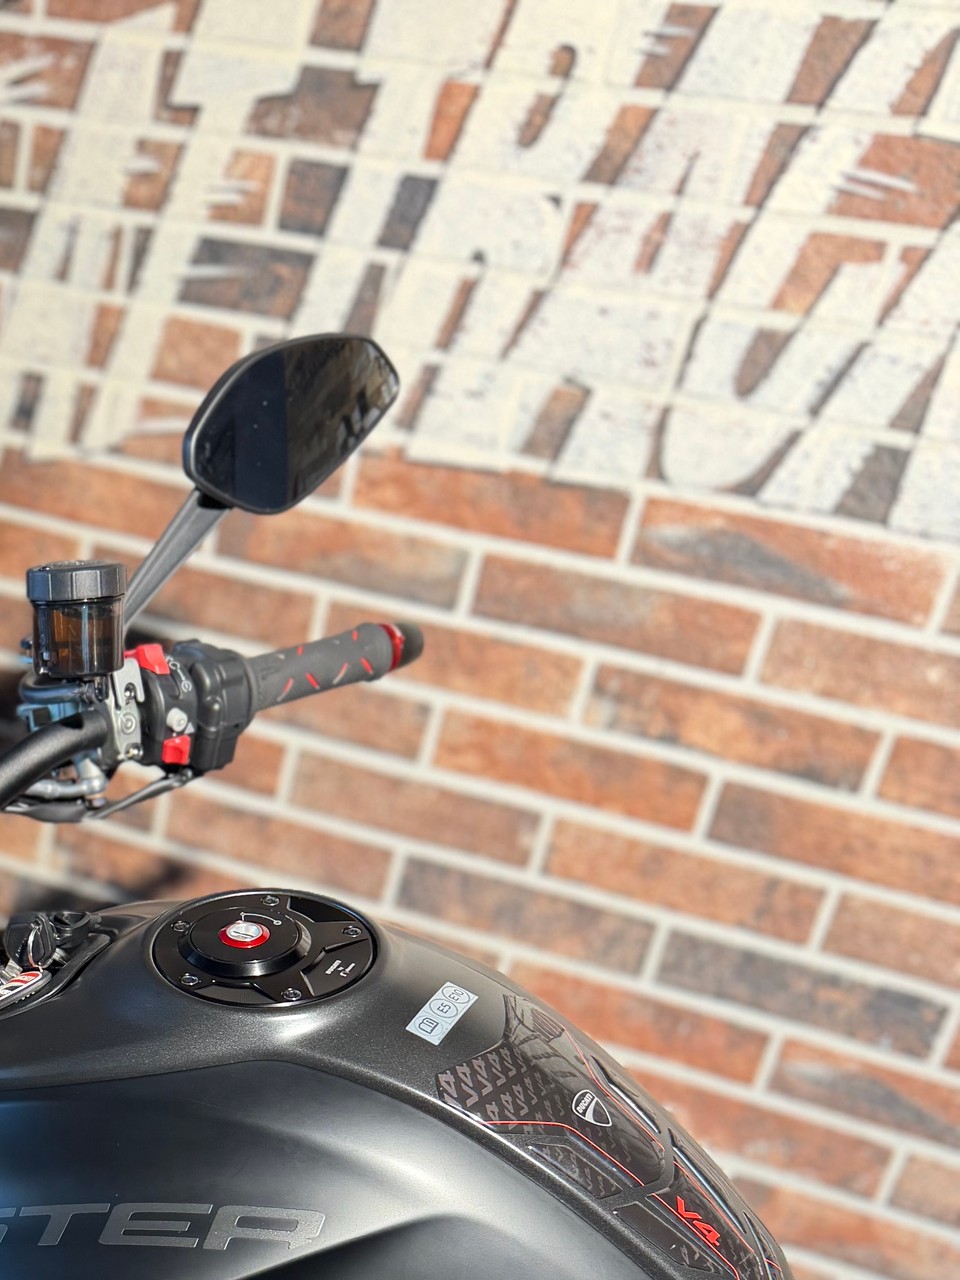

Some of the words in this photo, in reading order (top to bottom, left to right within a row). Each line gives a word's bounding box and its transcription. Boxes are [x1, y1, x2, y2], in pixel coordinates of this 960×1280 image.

[448, 988, 466, 1003] E10
[438, 1003, 452, 1014] E5
[576, 1093, 593, 1113] DUCATI
[676, 1195, 720, 1246] V4
